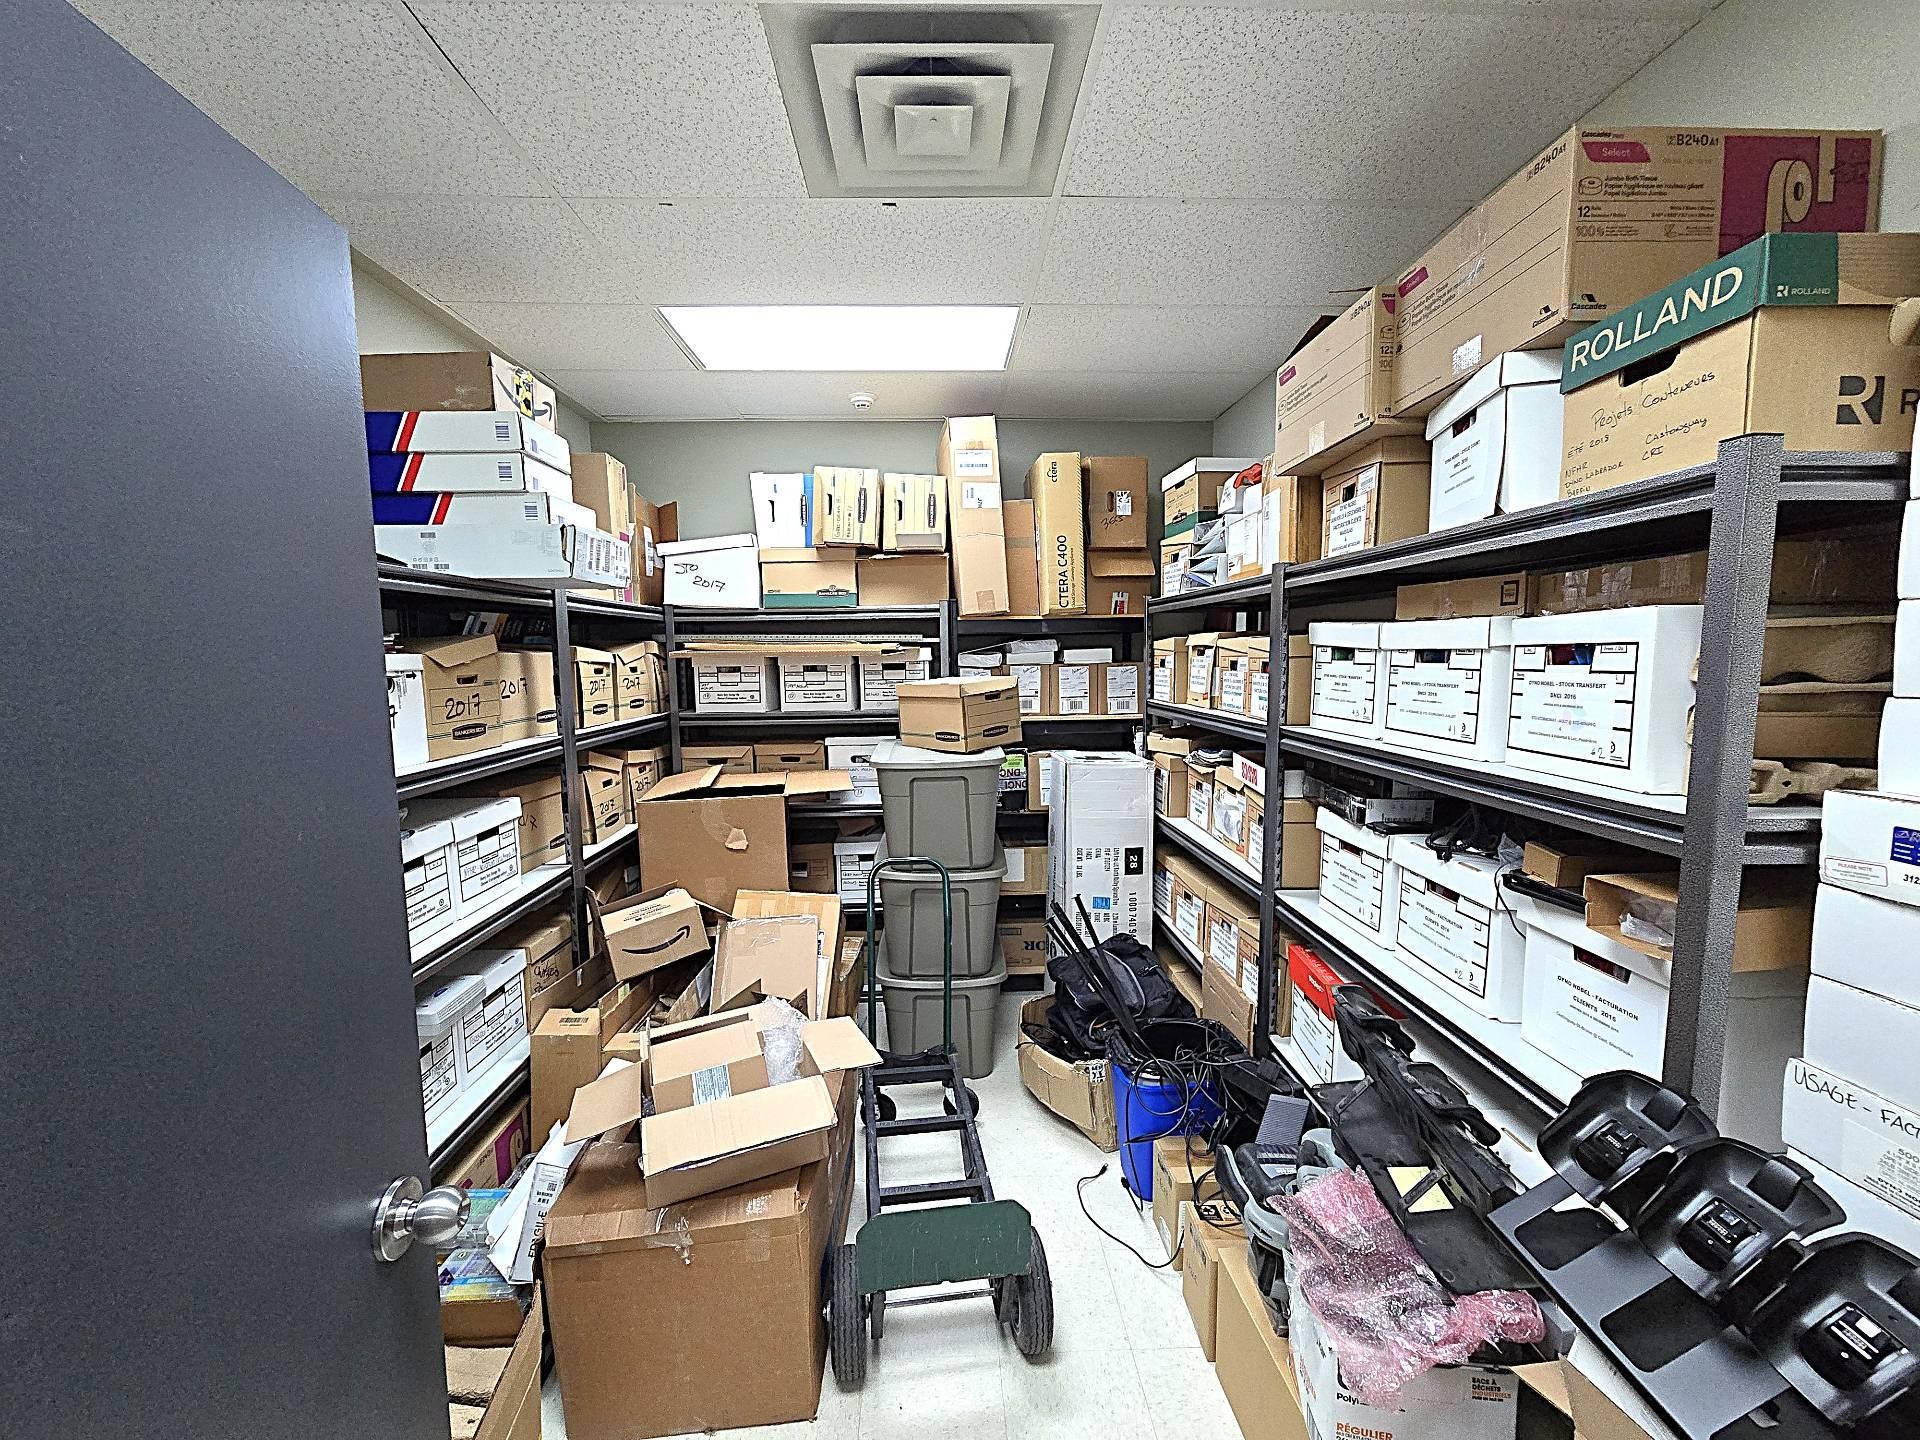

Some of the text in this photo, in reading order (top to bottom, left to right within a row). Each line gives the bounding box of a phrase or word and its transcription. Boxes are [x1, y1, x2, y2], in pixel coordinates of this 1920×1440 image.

[1602, 147, 1630, 157] Select
[1577, 205, 1591, 218] 12
[1791, 287, 1831, 295] ROLLAND
[1571, 302, 1608, 310] Cascades
[1571, 267, 1743, 372] ROLLAND
[1592, 371, 1716, 432] Projets Conteneurs
[1901, 389, 1920, 414] R
[1641, 446, 1664, 461] CRI
[1047, 461, 1058, 483] ctera
[1057, 535, 1069, 608] CTERA C400
[692, 575, 726, 592] 2017
[500, 677, 528, 699] 2017
[590, 679, 606, 696] 2017
[623, 677, 641, 690] 2017
[445, 693, 480, 720] 2017
[454, 728, 475, 736] BANKERS
[999, 768, 1020, 777] DNC
[600, 799, 614, 815] 2017
[1129, 855, 1138, 868] 28
[1903, 874, 1920, 885] 312
[1572, 983, 1591, 997] NOBEL
[1595, 995, 1639, 1021] FACTURATION
[1573, 995, 1598, 1012] CLIENTS
[1794, 1065, 1858, 1109] USAGE
[1880, 1109, 1920, 1139] FACT
[1472, 1377, 1490, 1385] SACS
[1472, 1384, 1501, 1392] DÉCHETS
[1336, 1393, 1359, 1405] Poly
[1472, 1390, 1511, 1398] INDUSTRIELS
[1337, 1422, 1393, 1440] RÉGULIER
